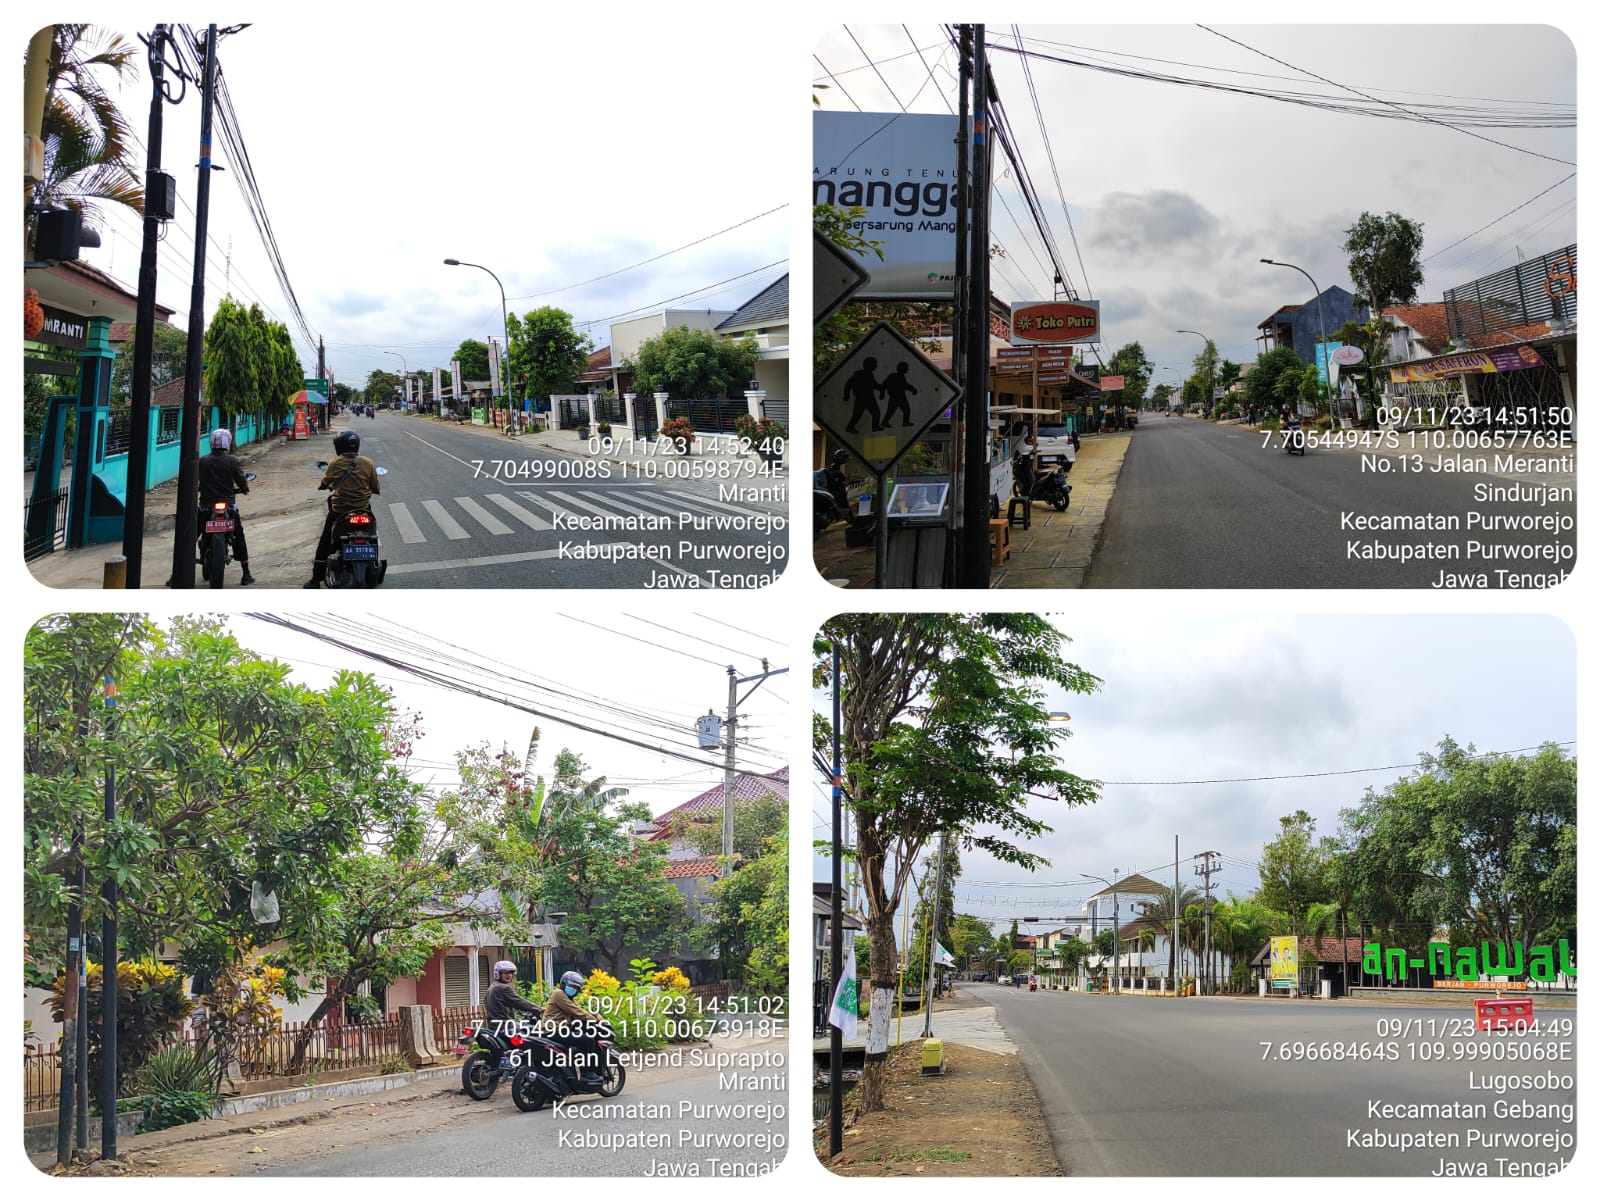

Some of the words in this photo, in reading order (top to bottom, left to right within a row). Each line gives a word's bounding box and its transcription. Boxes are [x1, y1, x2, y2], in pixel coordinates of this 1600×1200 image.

[44, 319, 83, 339] MRANTI
[1036, 316, 1064, 330] Toko
[1067, 314, 1095, 328] Putri
[1422, 362, 1439, 373] RM
[1437, 353, 1488, 370] SAFFRON
[1473, 981, 1522, 989] PURWOREJO
